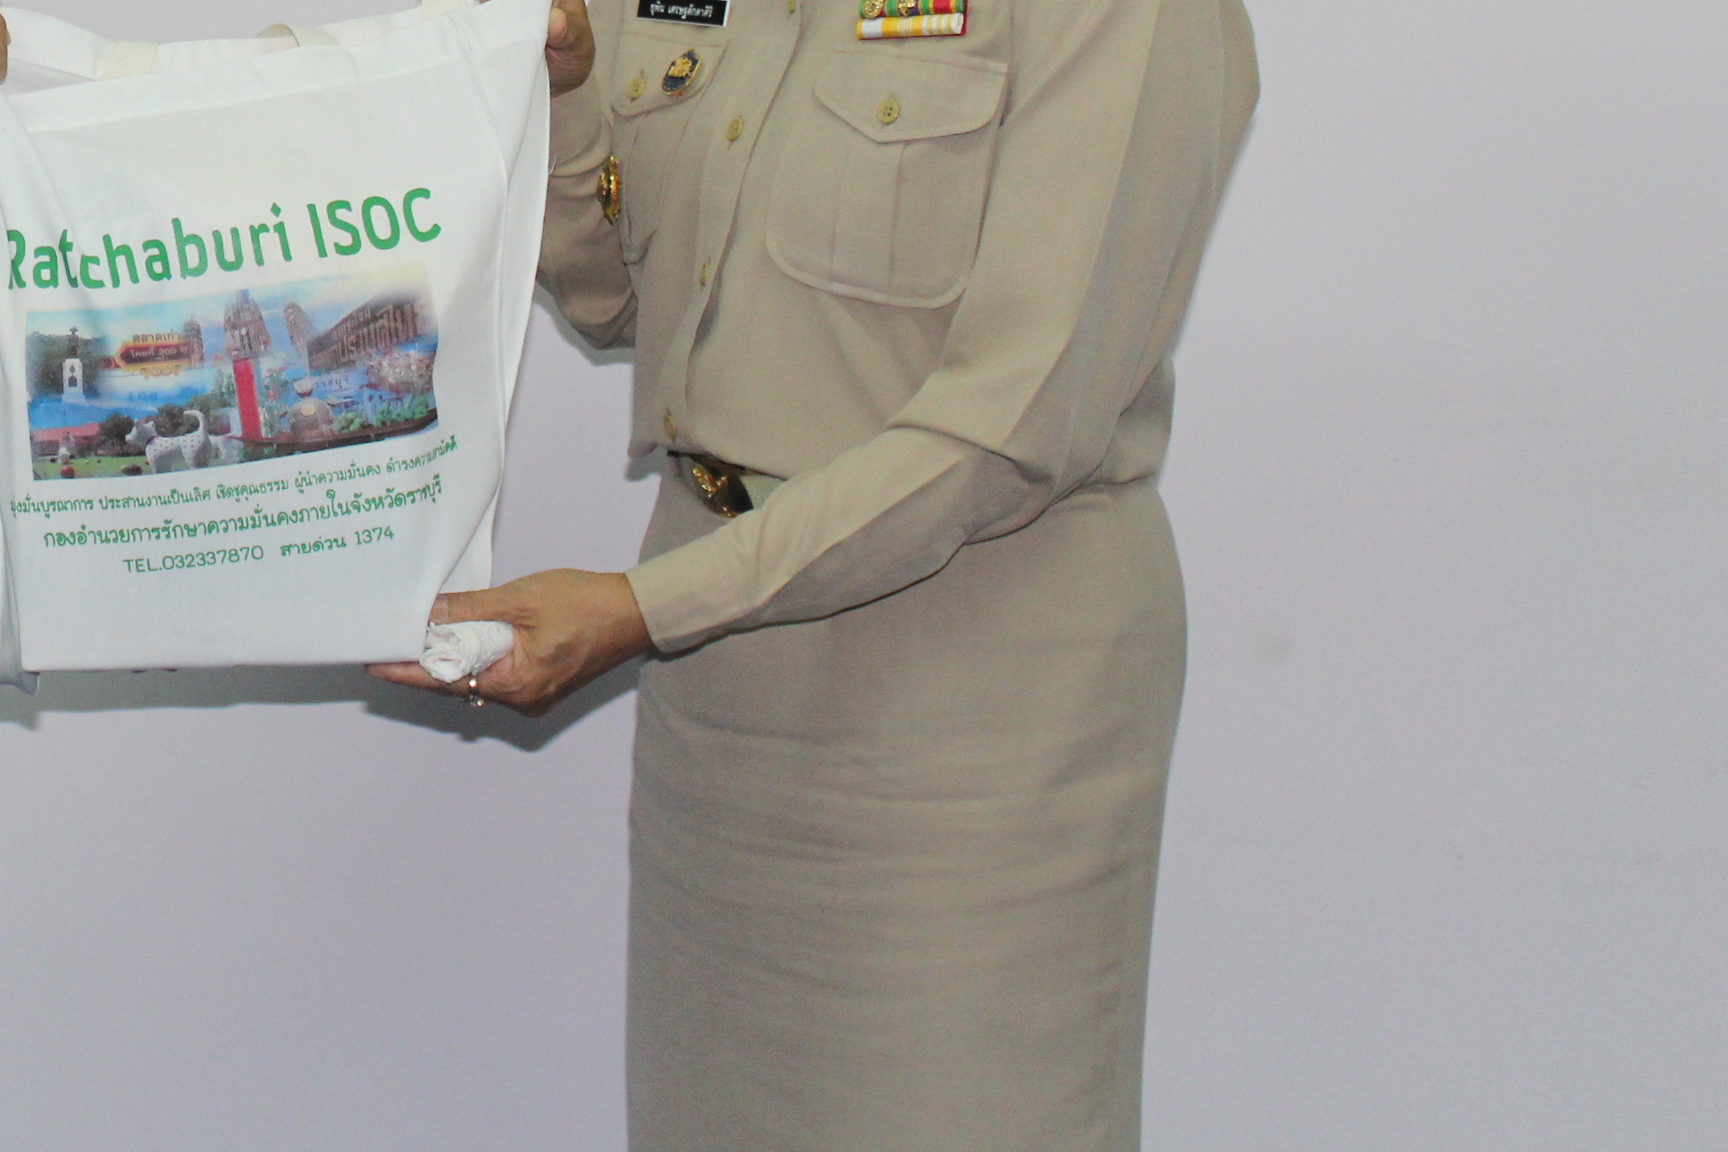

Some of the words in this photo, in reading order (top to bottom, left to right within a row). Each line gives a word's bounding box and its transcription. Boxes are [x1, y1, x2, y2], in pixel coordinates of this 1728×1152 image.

[7, 202, 292, 289] Ratchaburi
[307, 187, 442, 258] ISOC
[43, 473, 443, 548] กองอำนวยการรักษาความมั่นคงภายในจังหวัดราชบุรี
[98, 486, 211, 510] ประสานงานเป็นเลิศ
[215, 478, 289, 503] เชิดชูคุณธรรม
[294, 460, 381, 494] ผู้นำความมั่นคง
[123, 545, 264, 574] TEL.032337870
[280, 535, 347, 556] สายด่วน
[354, 525, 395, 545] 1374
